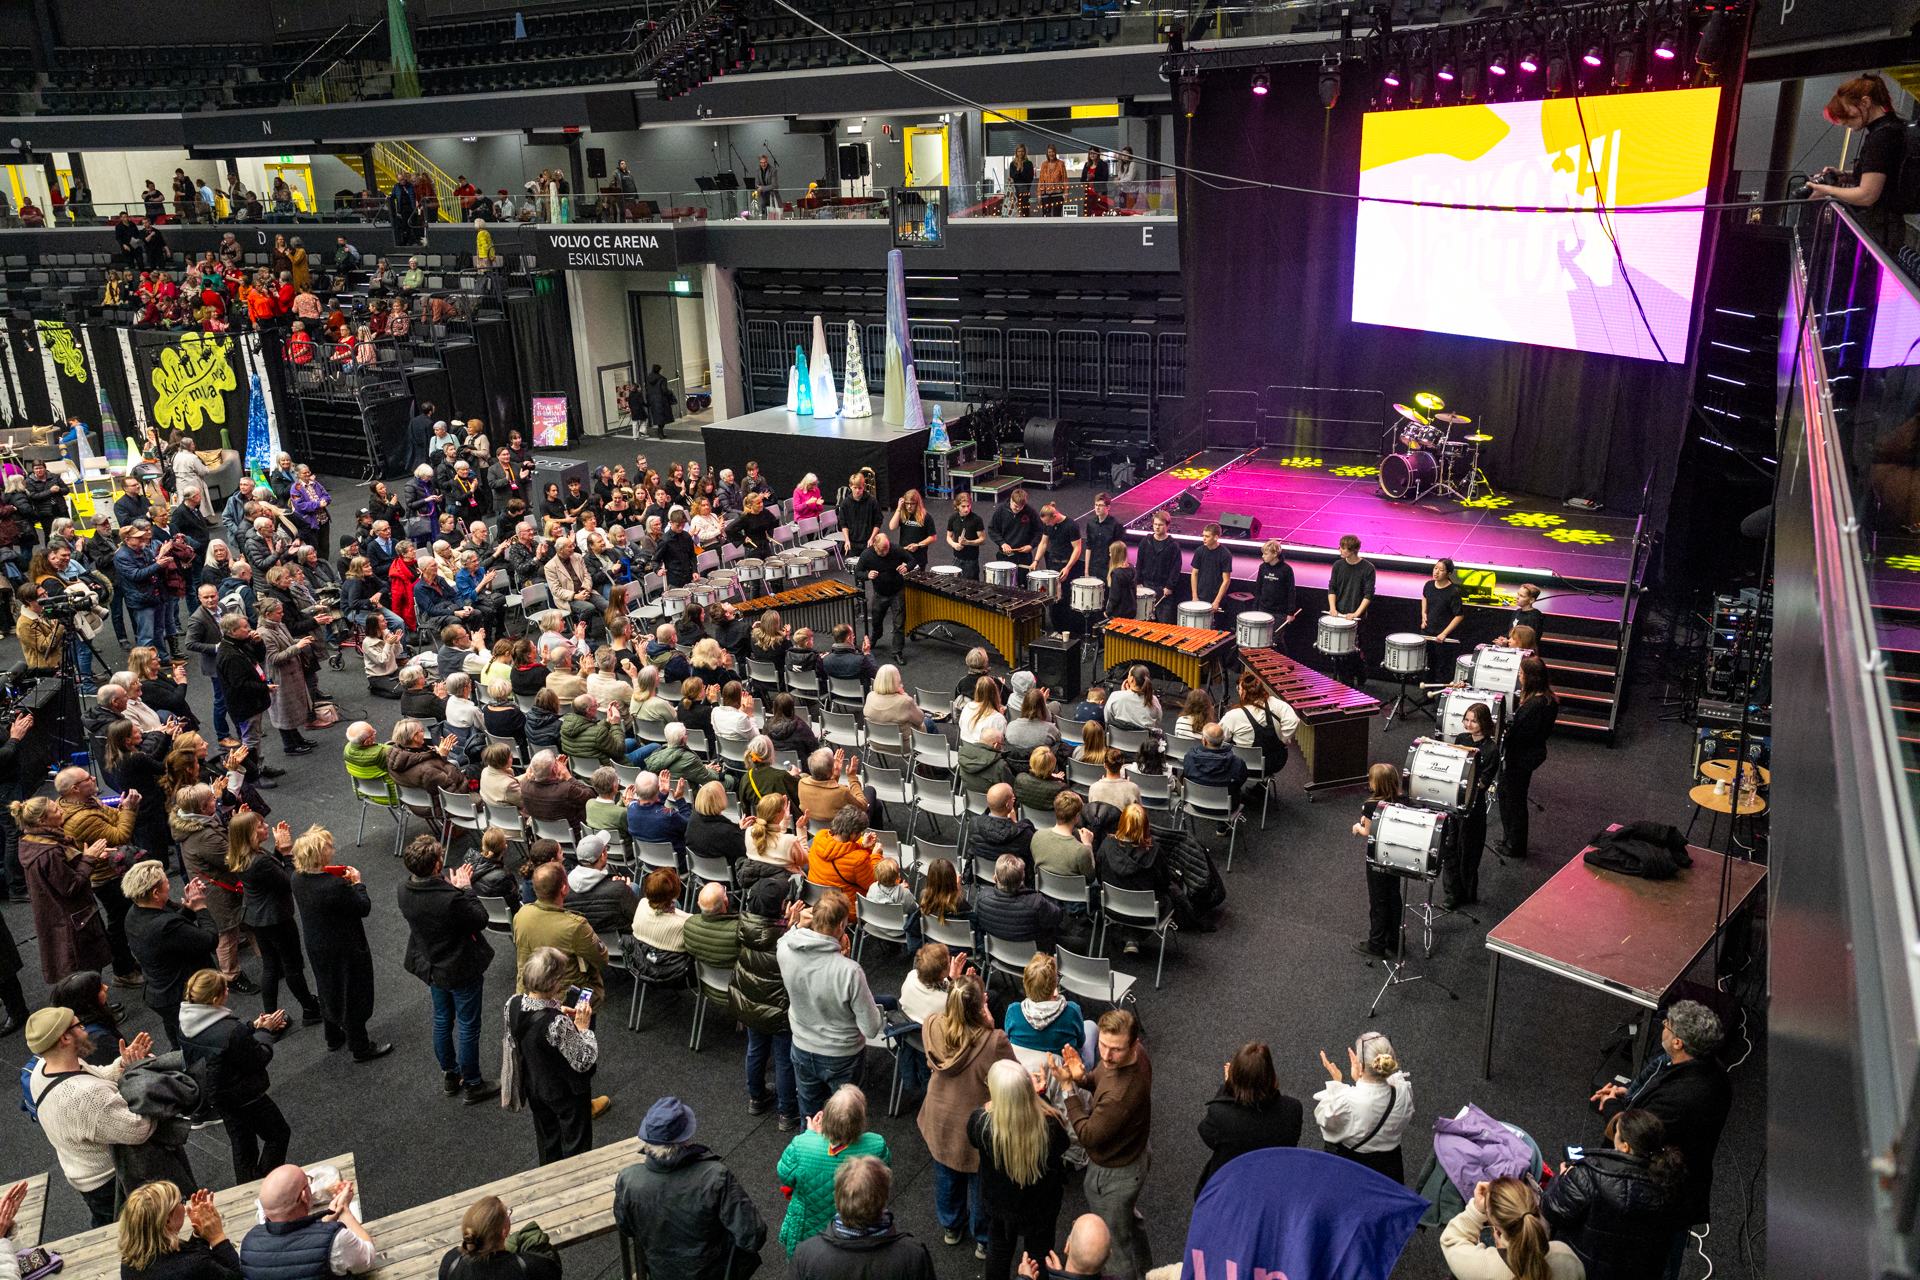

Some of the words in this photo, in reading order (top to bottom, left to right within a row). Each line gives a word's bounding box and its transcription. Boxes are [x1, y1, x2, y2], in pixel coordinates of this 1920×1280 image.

[262, 120, 272, 135] N
[257, 231, 267, 245] D
[550, 235, 590, 248] VOLVO
[593, 235, 611, 248] CE
[614, 235, 659, 249] ARENA
[1142, 226, 1154, 246] E
[568, 252, 644, 266] ESKILSTUNA
[174, 367, 227, 422] Sömland
